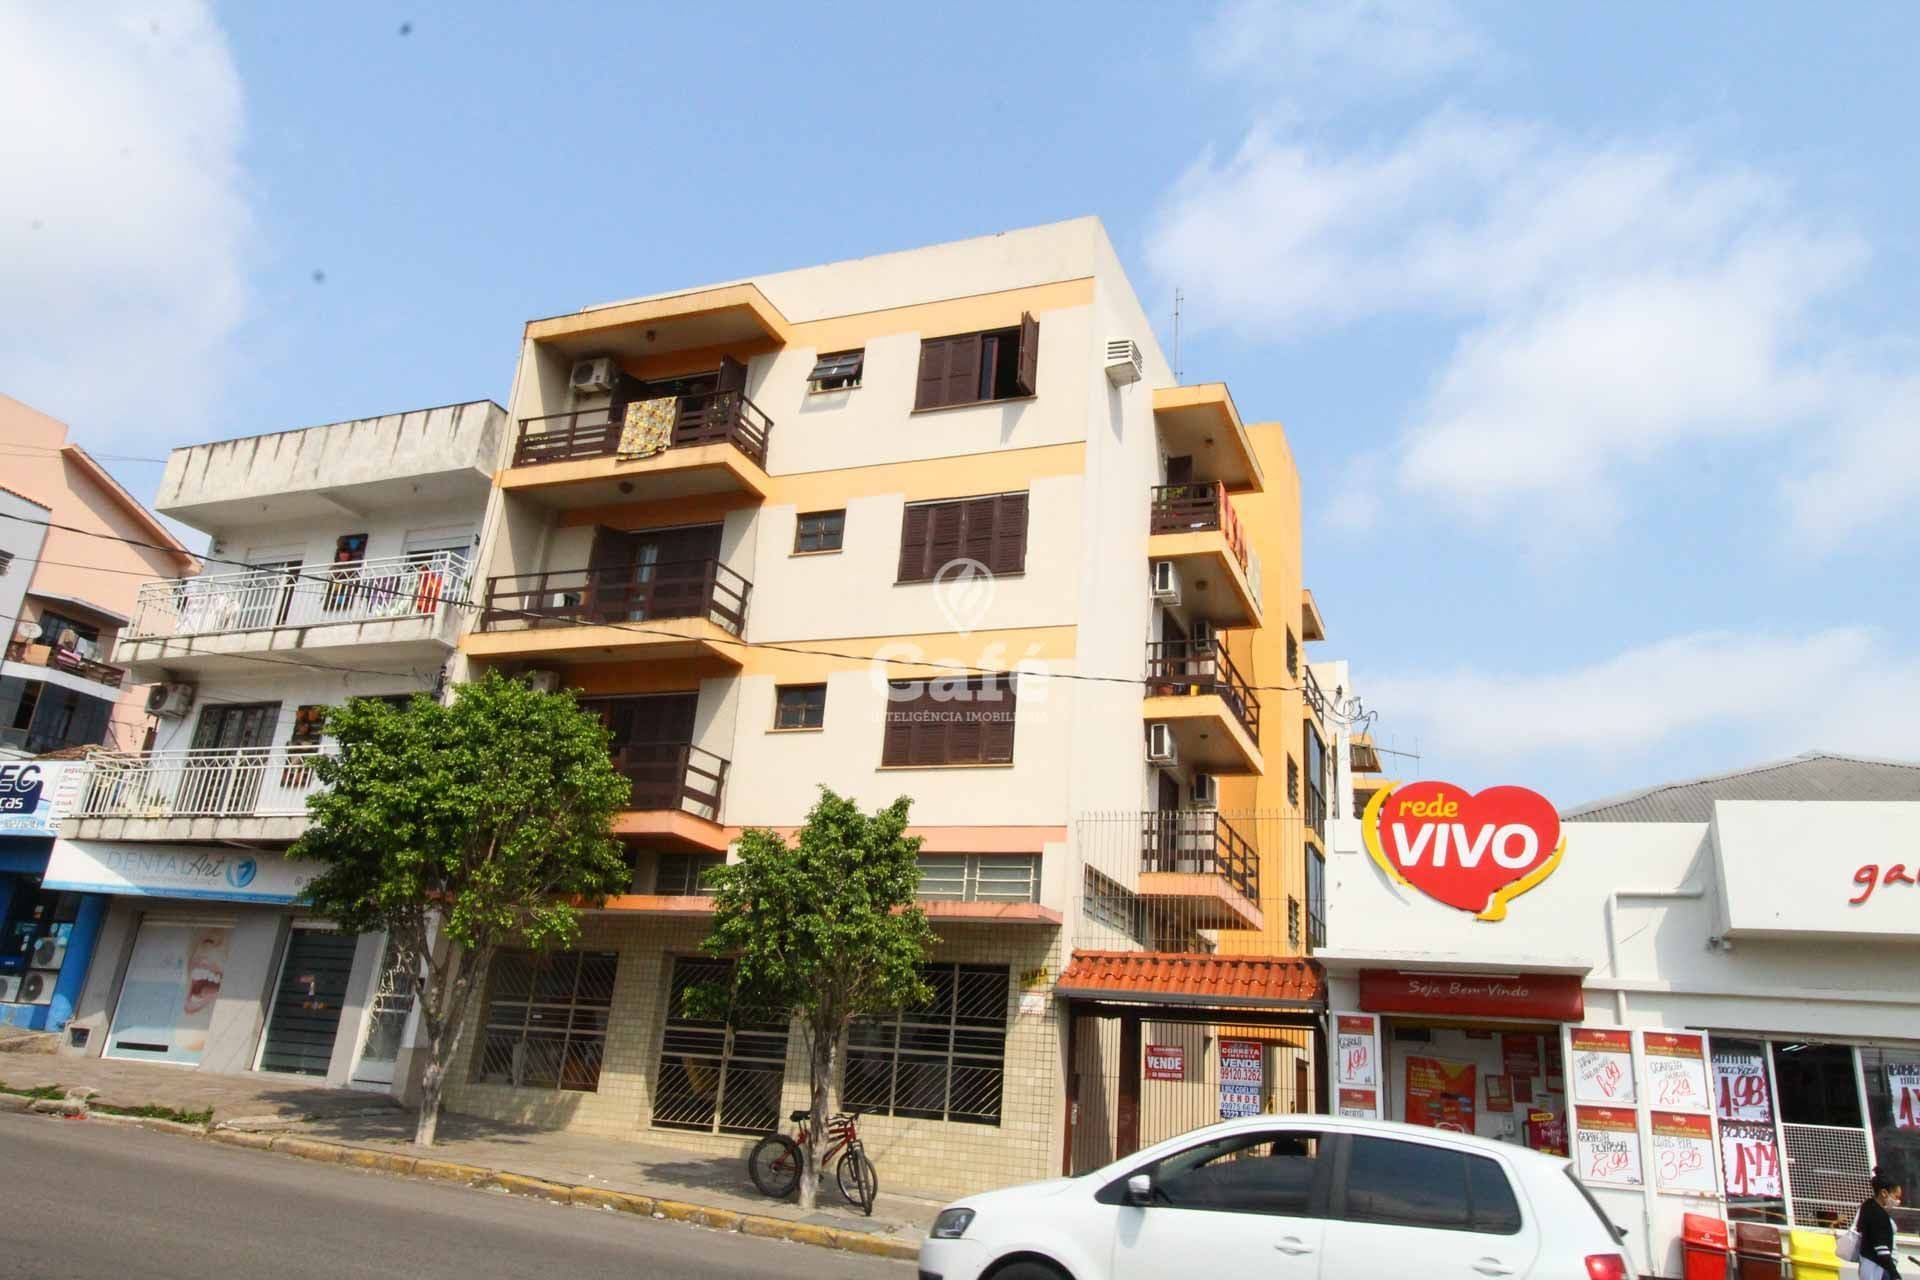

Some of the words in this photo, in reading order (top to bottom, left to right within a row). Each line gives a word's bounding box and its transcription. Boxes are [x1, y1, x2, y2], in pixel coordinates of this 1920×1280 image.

[0, 764, 41, 792] EC
[1399, 793, 1458, 817] rede
[1391, 823, 1539, 869] VIVO
[1848, 863, 1920, 905] ga
[1408, 980, 1440, 998] Seja
[1449, 982, 1529, 997] Bem-Vindo
[1147, 1056, 1182, 1070] VENDE
[1221, 1059, 1261, 1069] VENDE
[1222, 1094, 1257, 1104] VENDE
